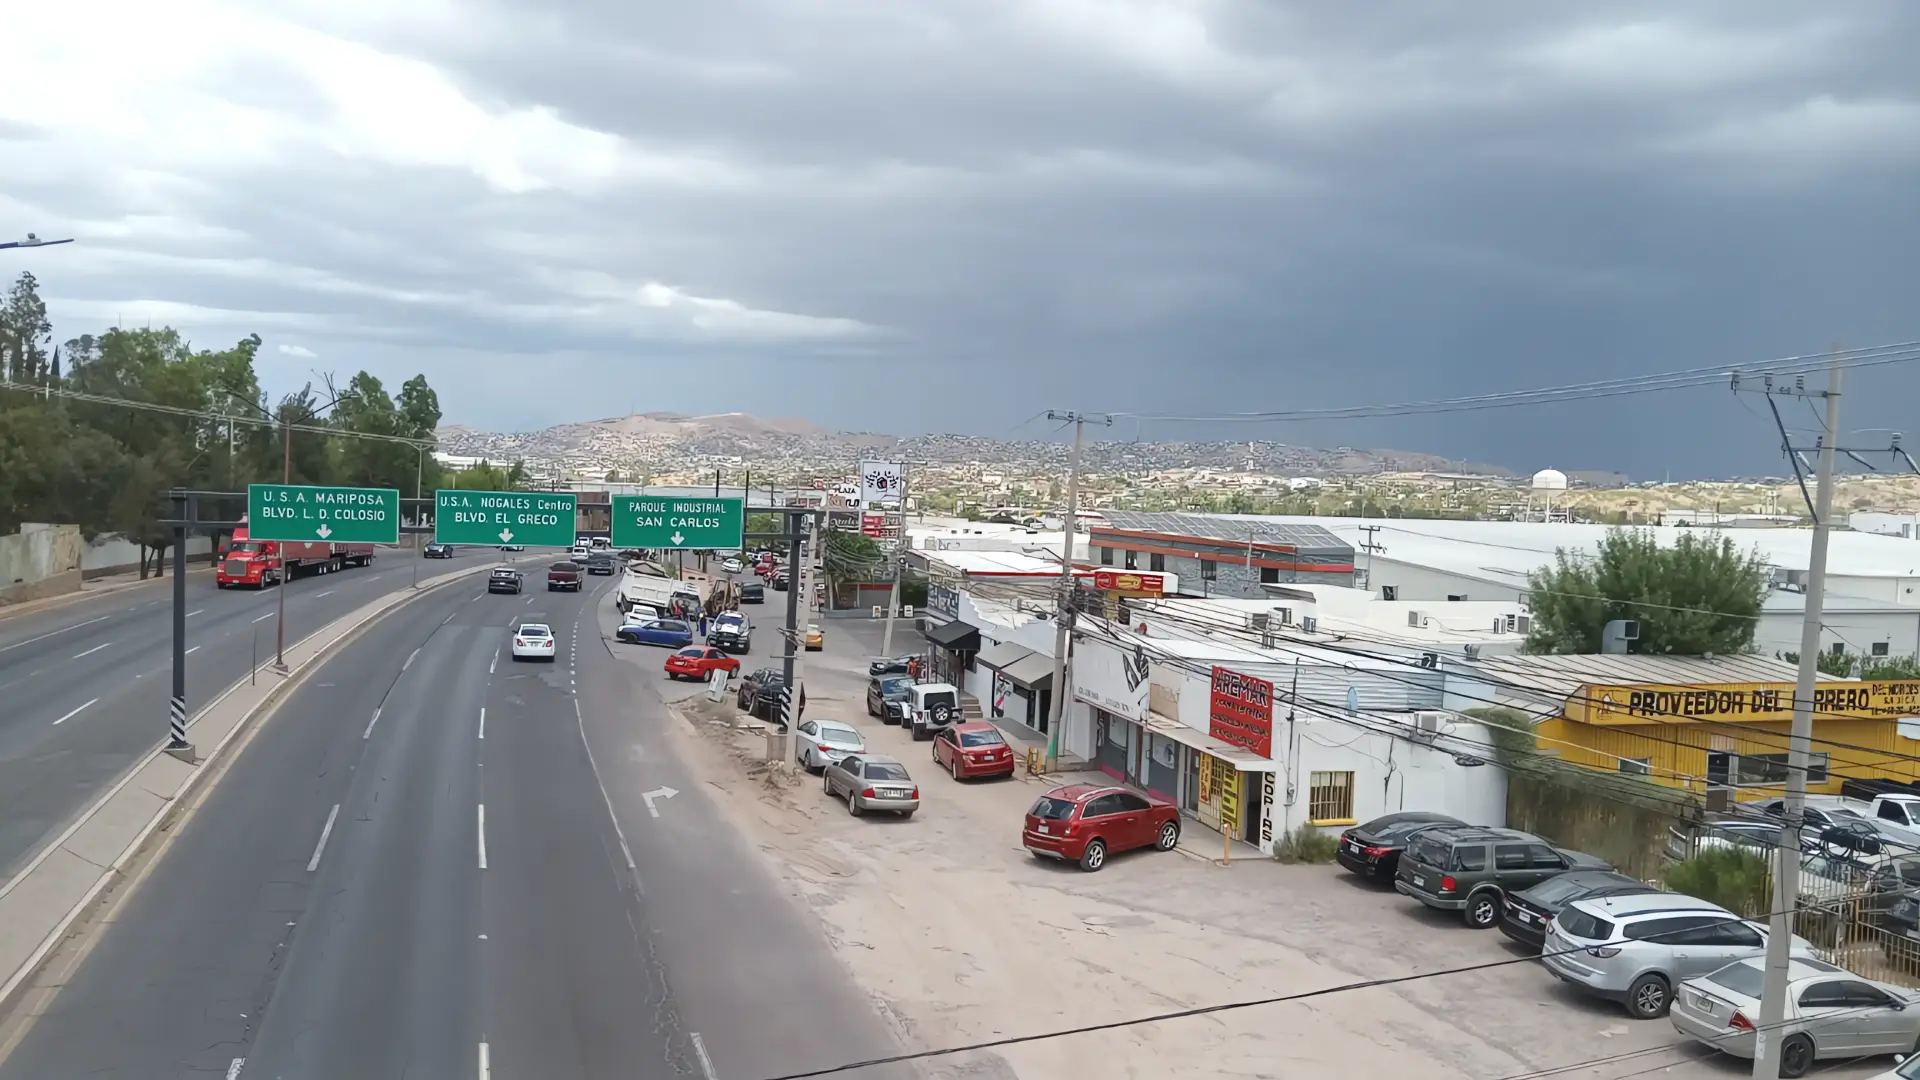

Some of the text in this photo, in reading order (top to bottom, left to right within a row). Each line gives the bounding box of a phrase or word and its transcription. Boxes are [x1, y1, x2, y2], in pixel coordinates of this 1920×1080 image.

[315, 493, 384, 505] MARIPOSA
[480, 497, 530, 509] NOGALES
[537, 499, 572, 511] Centro
[262, 507, 298, 518] BLVD.
[334, 510, 385, 520] COLOSIO
[629, 502, 727, 514] PARQUE INDUSTRIAL
[495, 512, 511, 524] EL
[517, 513, 558, 525] GRECO
[636, 516, 720, 528] SAN CARLOS
[1213, 671, 1268, 707] AREMAR
[1629, 691, 1744, 716] PROVEEDOR
[1750, 689, 1784, 713] DEL
[1262, 772, 1276, 842] COPIAS
